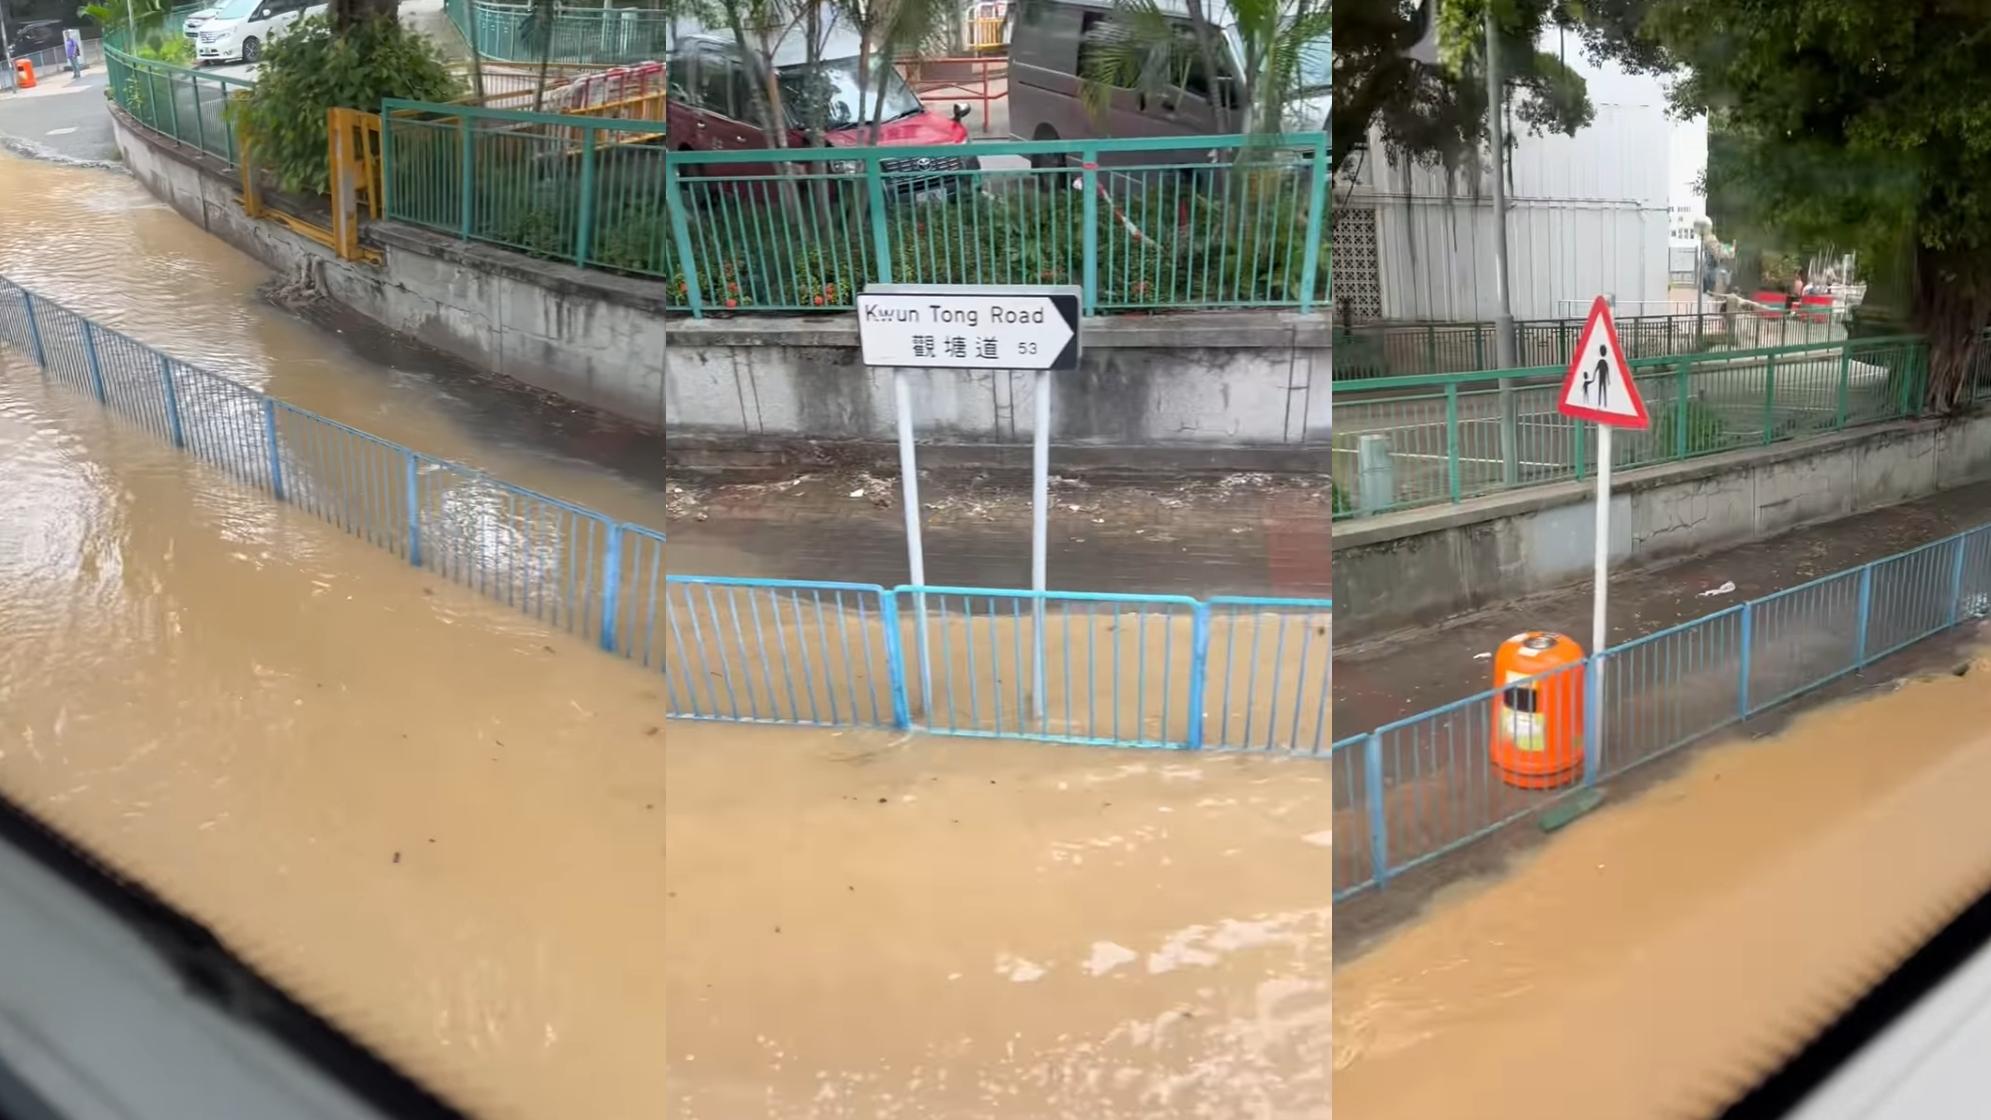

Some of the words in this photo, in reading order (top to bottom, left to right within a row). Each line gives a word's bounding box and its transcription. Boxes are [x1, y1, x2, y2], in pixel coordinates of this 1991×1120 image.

[864, 305, 920, 323] Kwun
[929, 305, 978, 327] Tong
[991, 306, 1044, 324] Road
[912, 335, 999, 359] 觀塘道
[1018, 342, 1038, 355] 53
